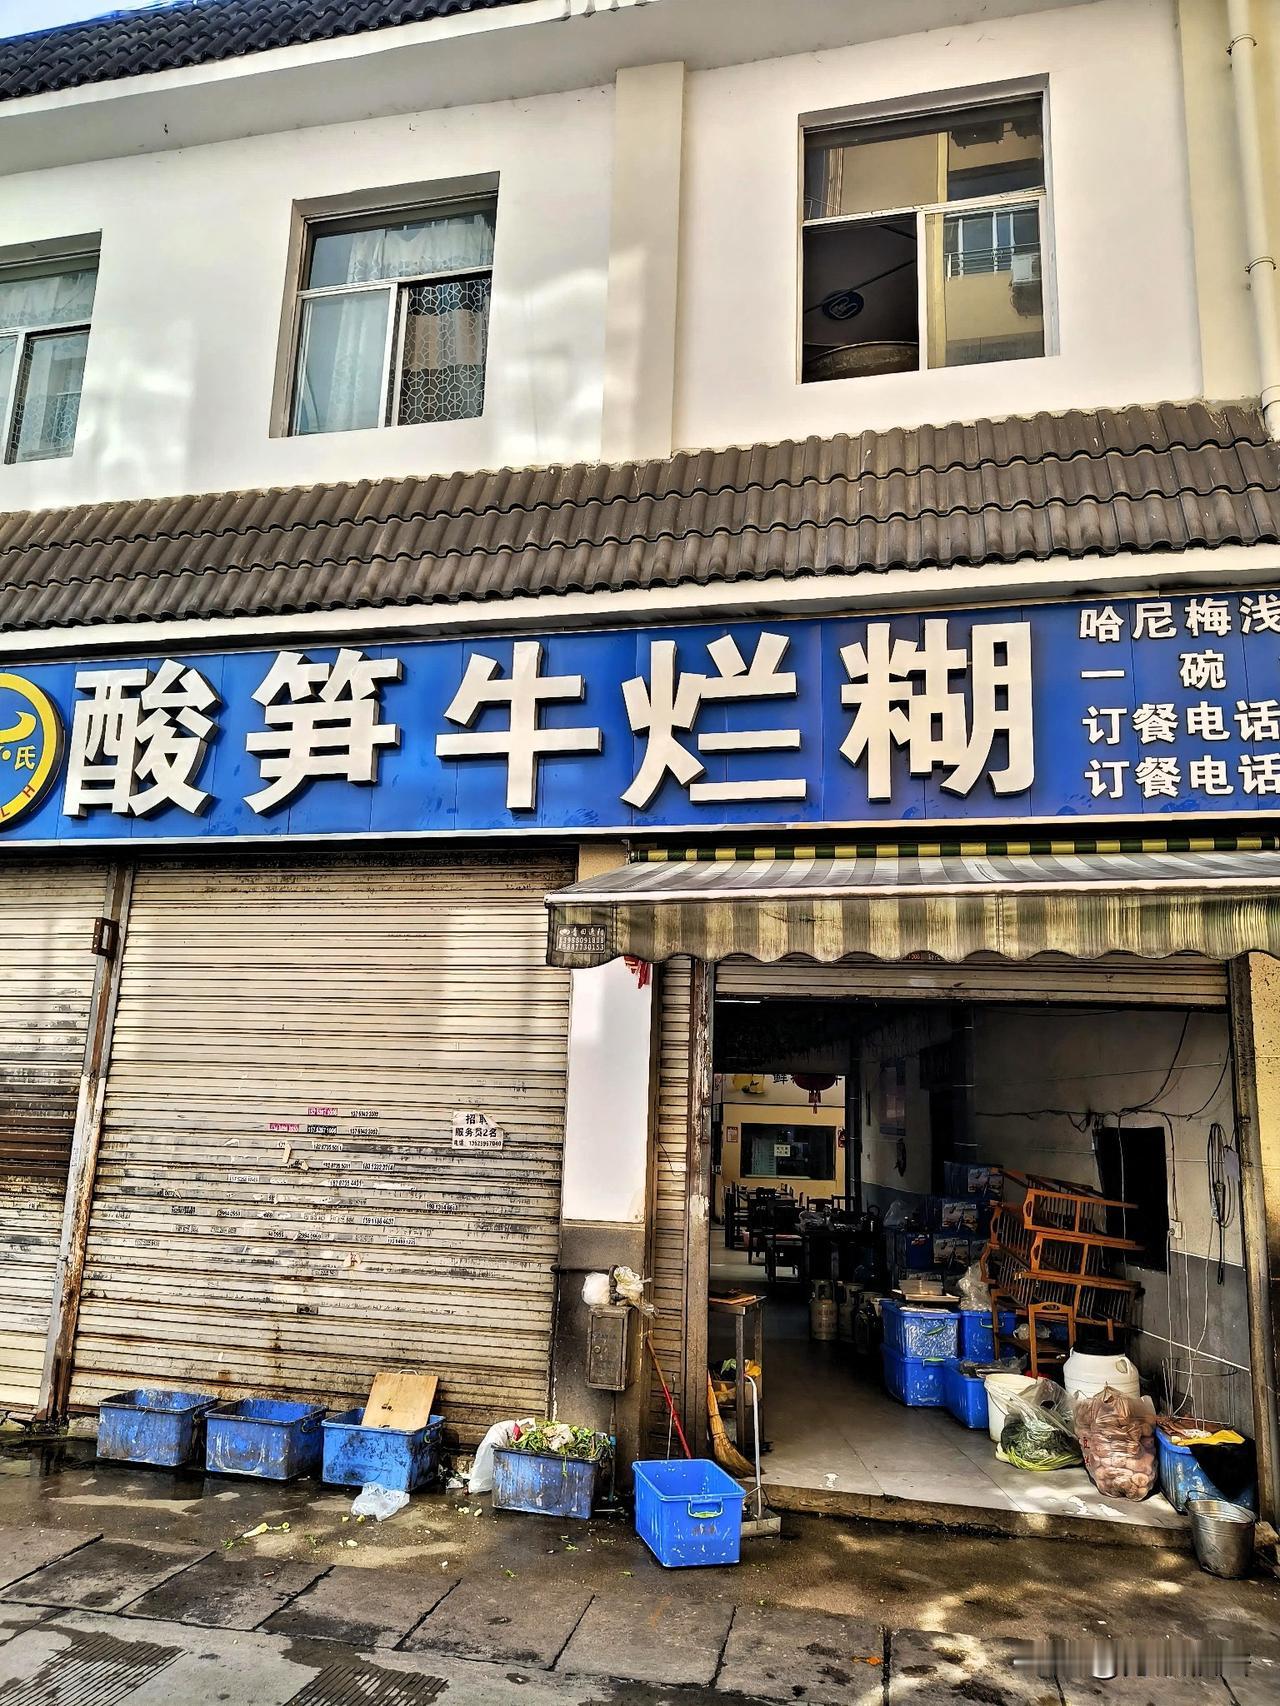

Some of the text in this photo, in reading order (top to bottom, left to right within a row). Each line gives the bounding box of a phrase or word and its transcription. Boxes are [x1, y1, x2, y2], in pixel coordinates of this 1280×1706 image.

[62, 617, 1034, 817] 酸笋牛烂糊
[1082, 699, 1280, 745] 订餐电话
[1084, 752, 1280, 799] 订餐电话
[455, 1127, 498, 1138] 服务员2名
